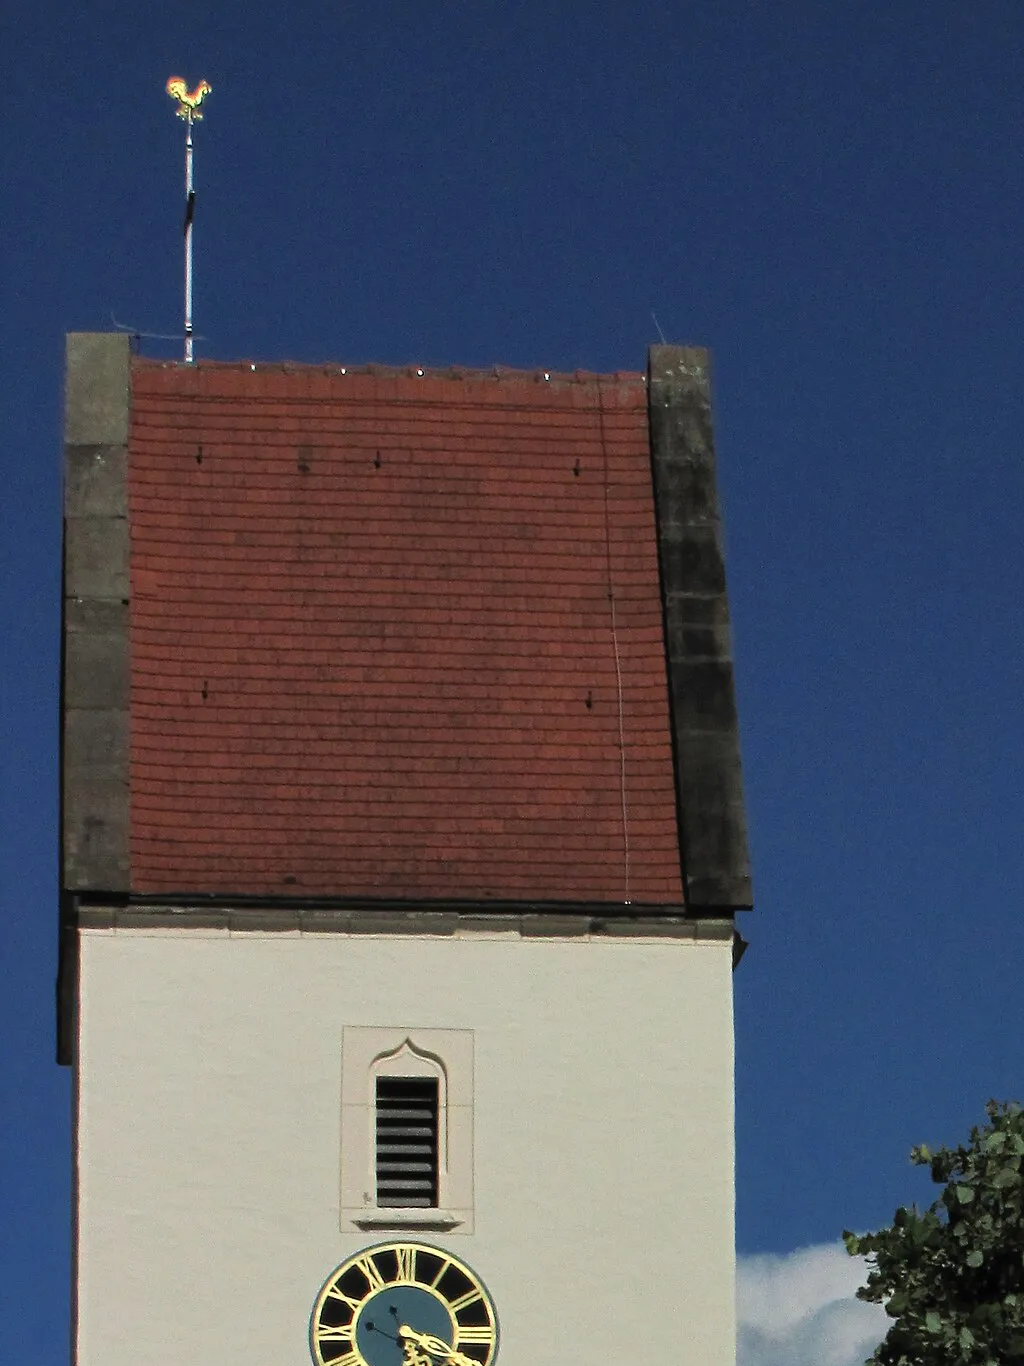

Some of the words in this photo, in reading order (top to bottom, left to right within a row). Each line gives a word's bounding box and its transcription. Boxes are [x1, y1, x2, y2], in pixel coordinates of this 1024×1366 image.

[356, 1256, 385, 1291] XI
[395, 1248, 417, 1282] XII
[430, 1260, 451, 1289] I
[329, 1285, 361, 1310] X
[449, 1289, 482, 1312] II
[318, 1323, 351, 1341] IX
[457, 1326, 493, 1344] III
